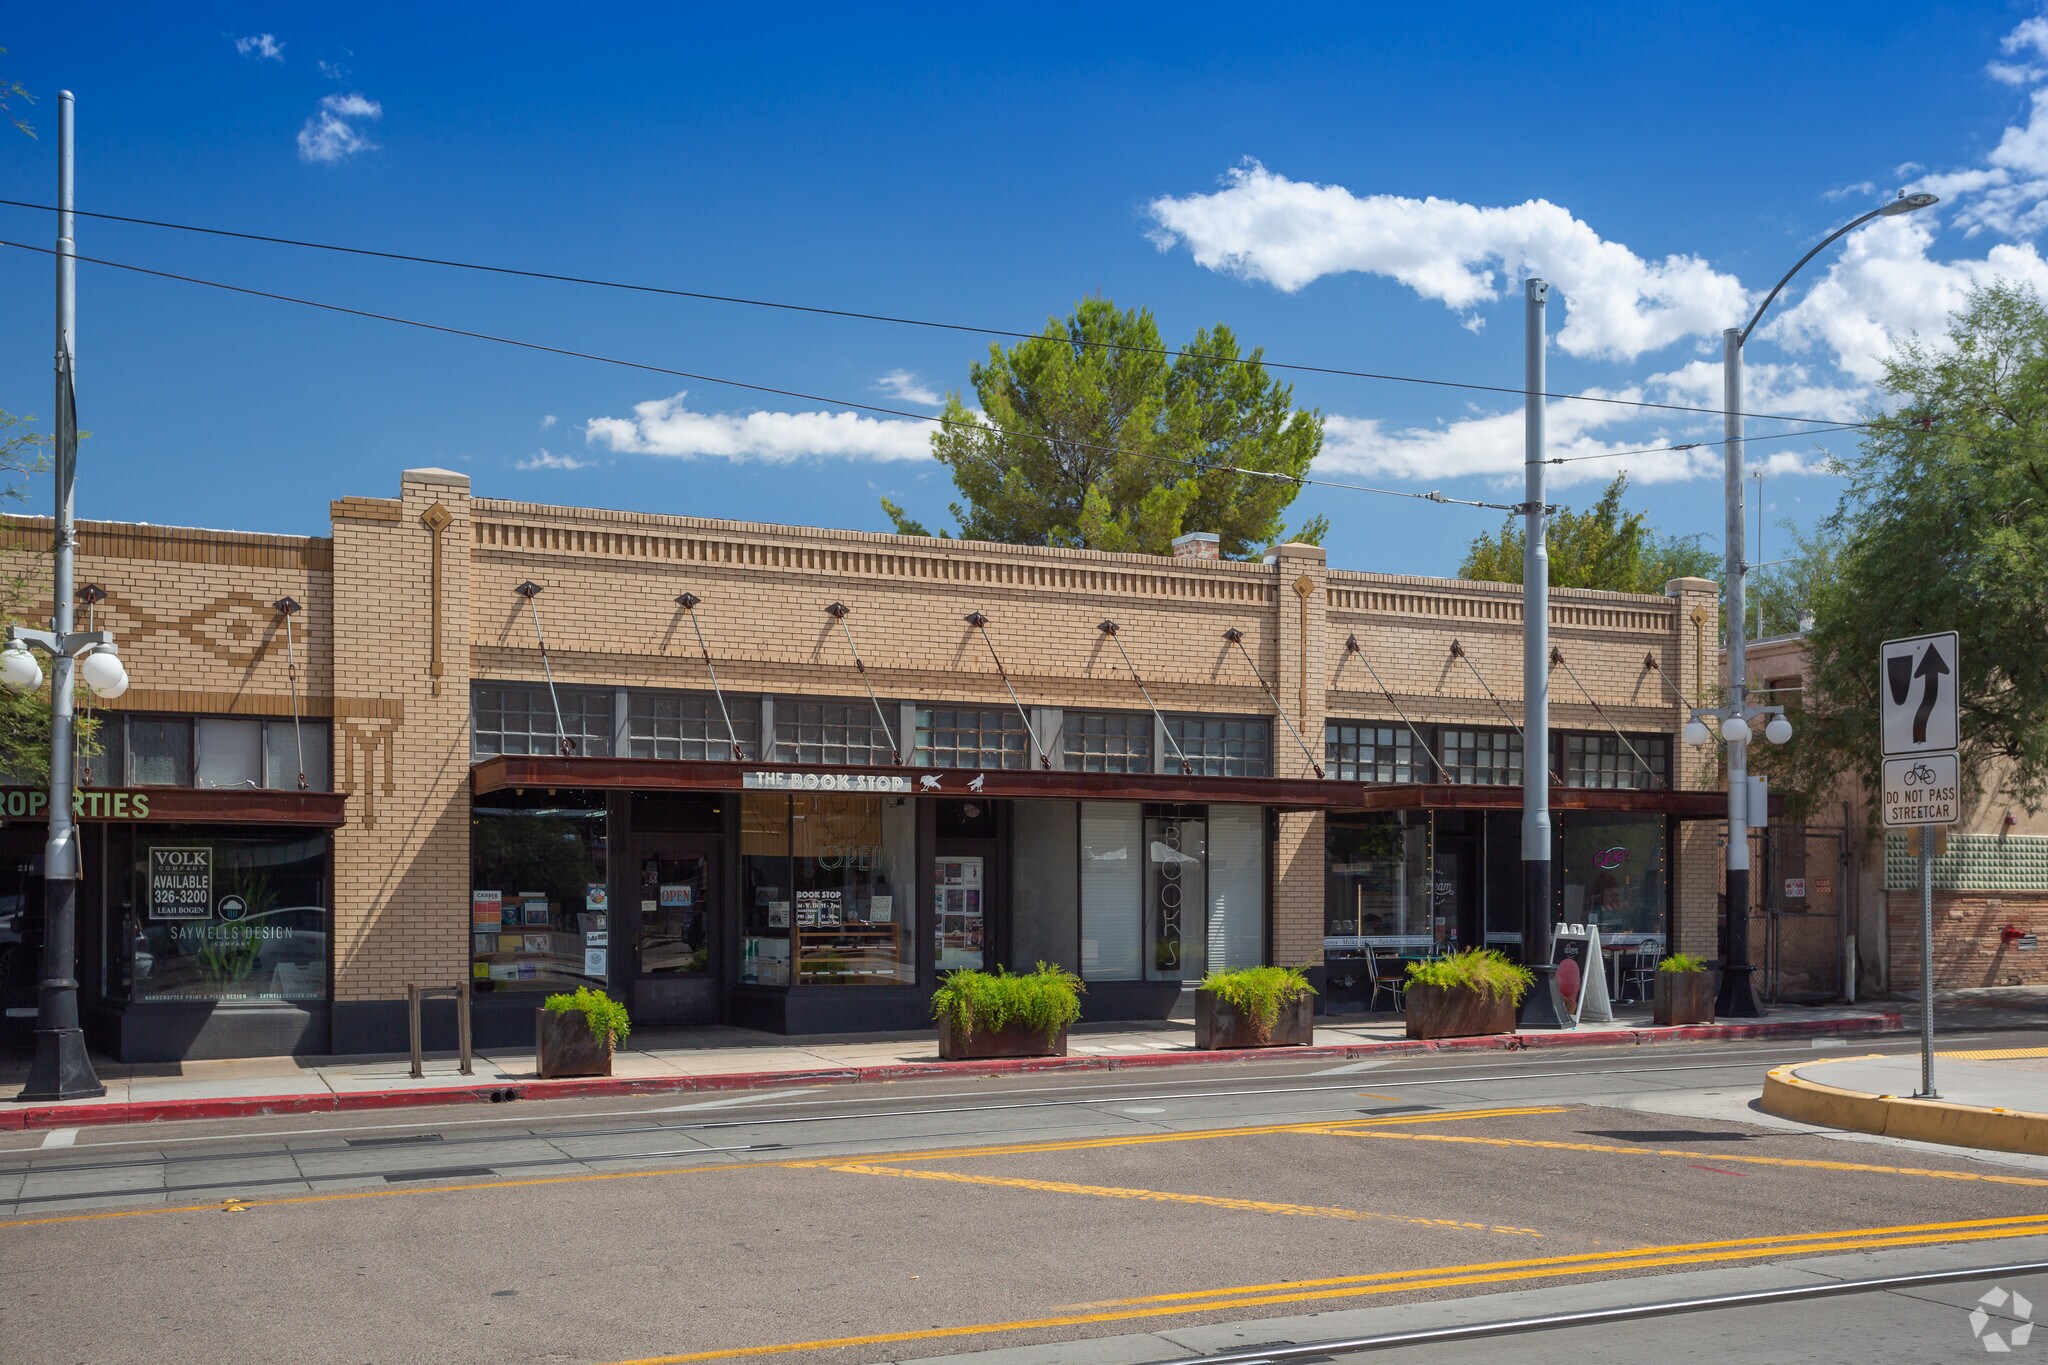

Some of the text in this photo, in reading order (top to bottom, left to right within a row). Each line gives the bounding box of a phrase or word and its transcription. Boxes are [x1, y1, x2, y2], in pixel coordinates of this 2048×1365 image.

[755, 772, 904, 792] THE BOOK STOP
[1886, 787, 1955, 804] DO NOT PASS
[0, 791, 150, 818] OPRTIES
[1892, 804, 1950, 820] STREETCAR
[155, 852, 207, 866] VOLK
[818, 845, 883, 871] OPEN
[17, 864, 35, 872] 218
[153, 875, 208, 889] AVAILABLE
[154, 890, 207, 903] 326-3200
[661, 889, 690, 903] OPEN
[796, 891, 841, 899] BOOK STOP
[1161, 826, 1183, 966] BOOKS
[170, 926, 293, 939] SAYWELLS DESIGN
